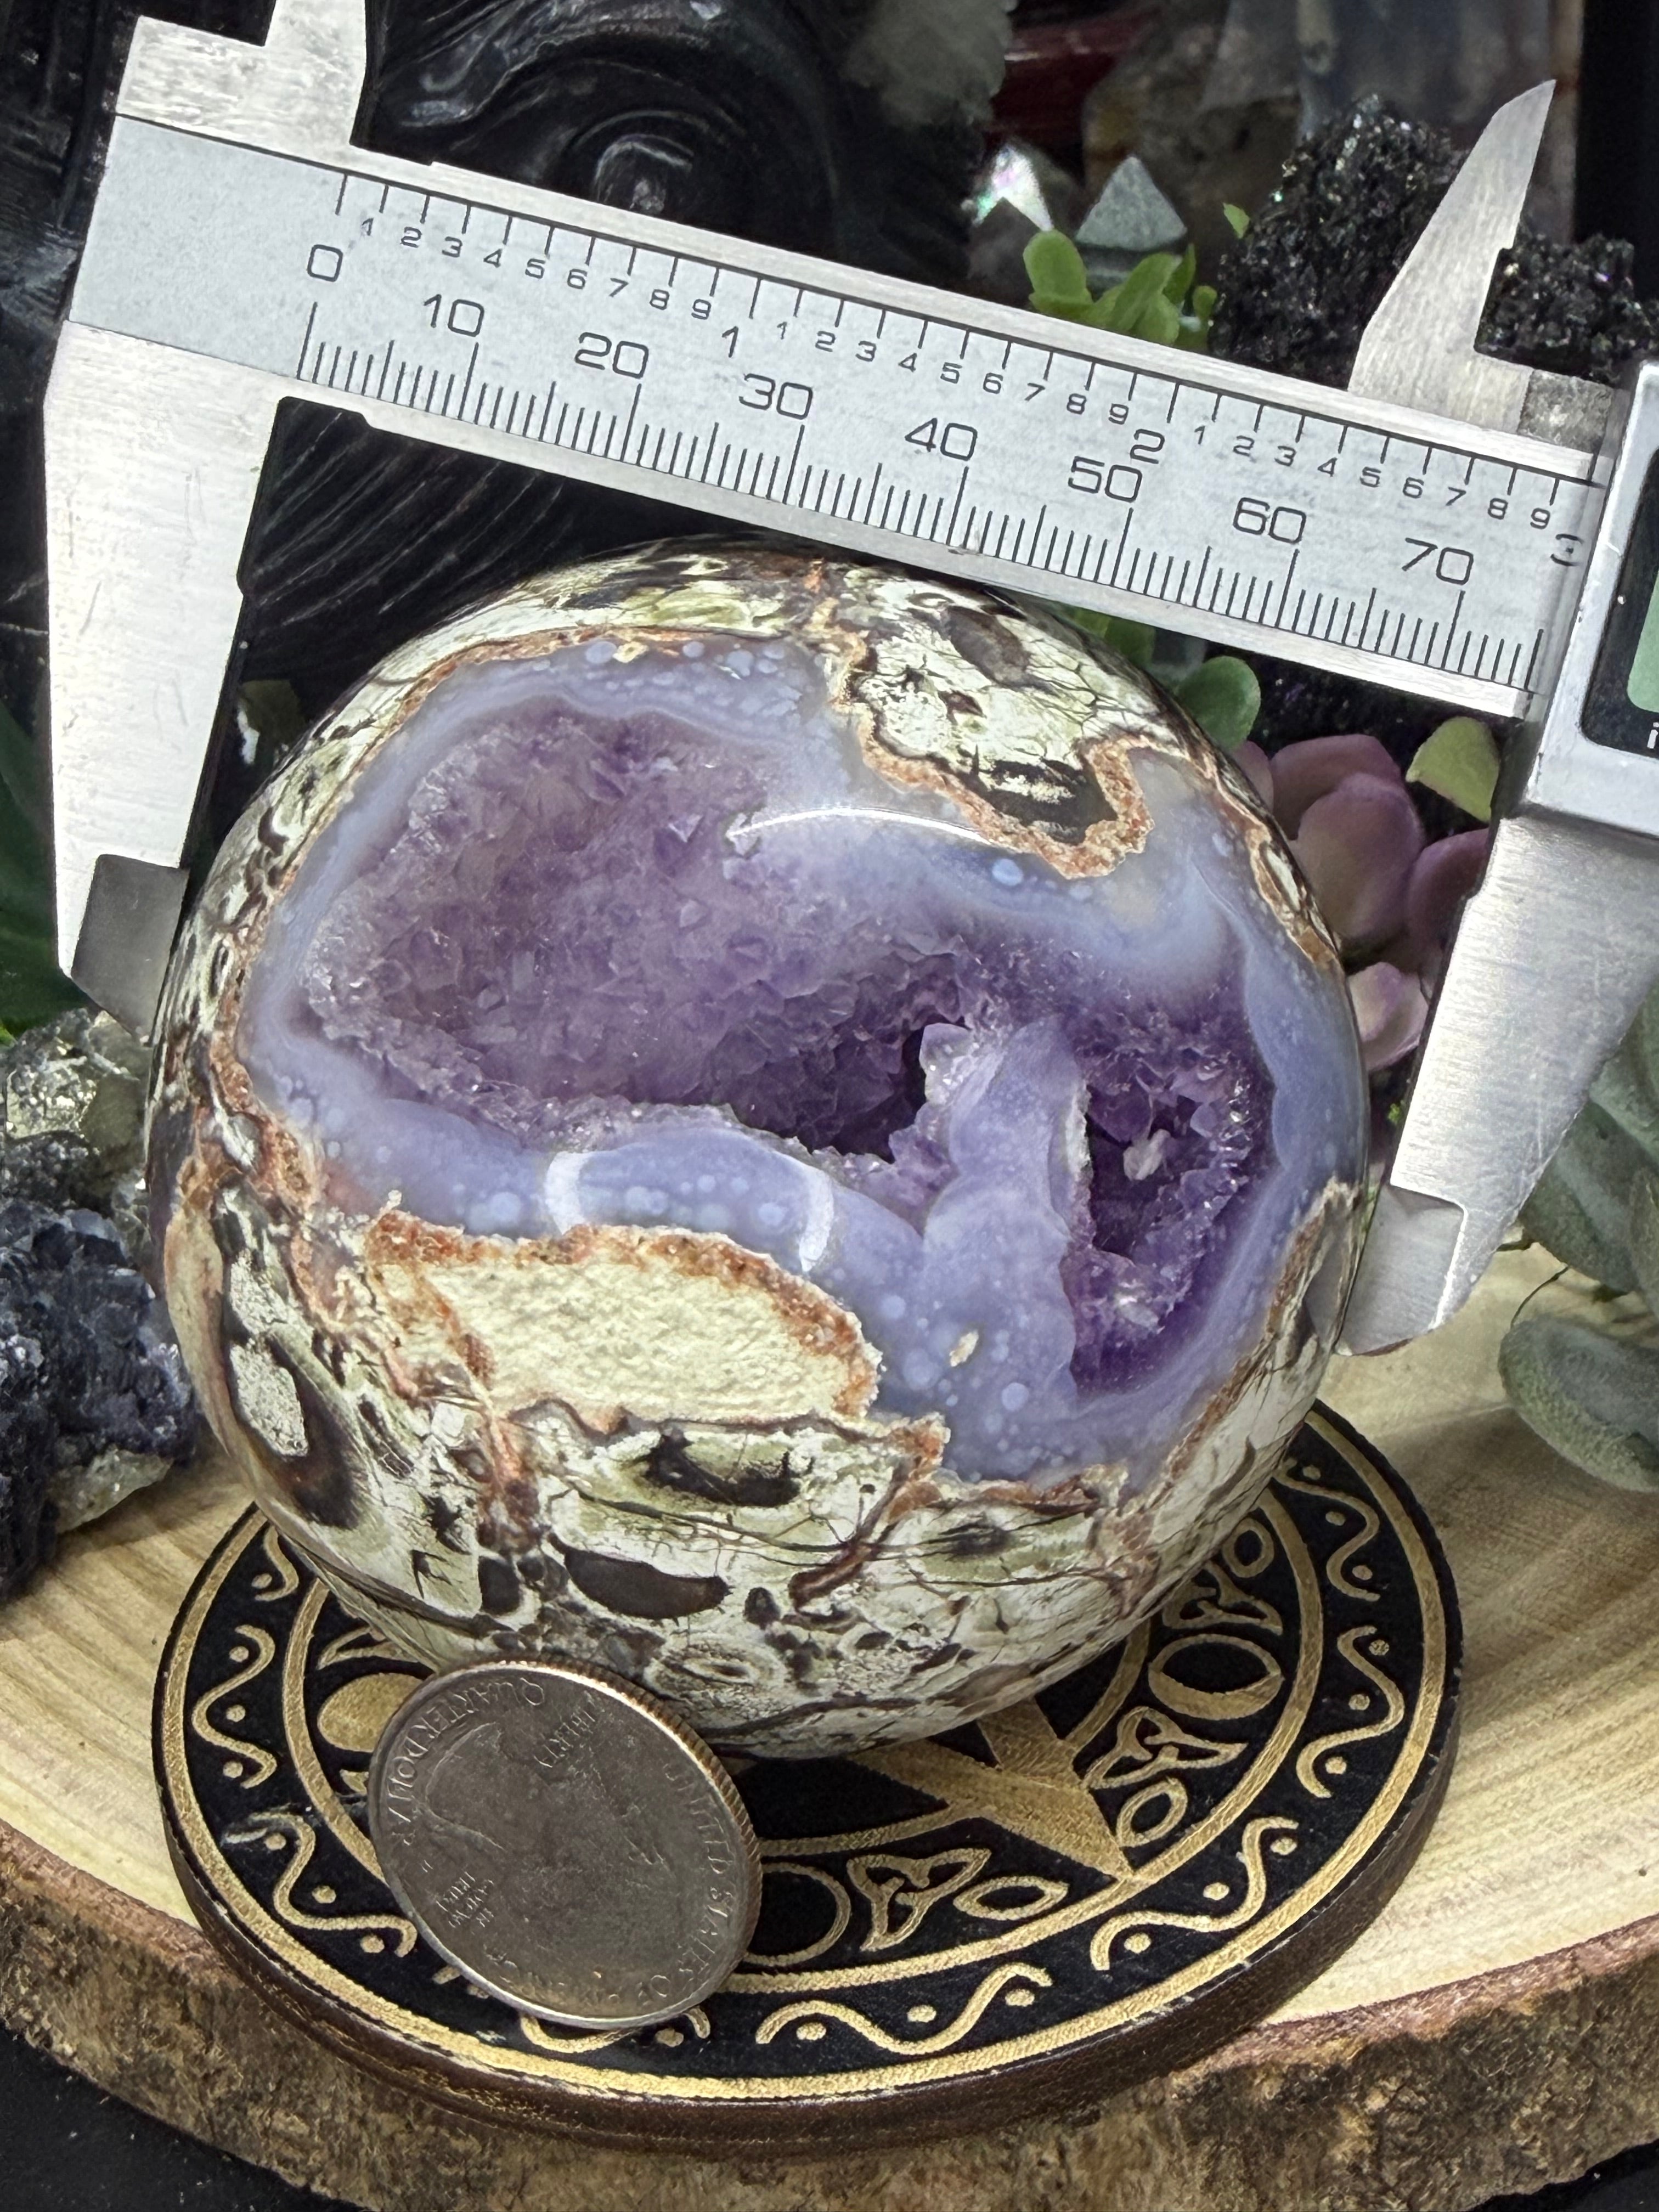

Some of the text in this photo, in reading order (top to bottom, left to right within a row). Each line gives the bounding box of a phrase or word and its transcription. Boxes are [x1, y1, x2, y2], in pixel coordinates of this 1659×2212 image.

[305, 243, 1475, 586] 0 10 20 30 40 50 60 70
[360, 217, 375, 237] 1
[399, 225, 423, 249] 2
[441, 235, 464, 259] 3
[482, 248, 503, 269] 4
[524, 257, 546, 280] 5
[566, 268, 588, 291] 6
[608, 277, 630, 298] 7
[648, 288, 671, 312] 8
[690, 298, 713, 321] 9
[721, 325, 740, 359] 1
[776, 320, 788, 341] 1
[814, 330, 837, 353] 2
[854, 340, 878, 363] 3
[897, 352, 918, 374] 4
[939, 361, 963, 385] 5
[982, 371, 1005, 395] 6
[1023, 382, 1046, 403] 7
[1065, 392, 1088, 416] 8
[1107, 403, 1130, 426] 9
[1128, 428, 1166, 465] 2
[1193, 425, 1206, 446] 1
[1232, 435, 1256, 458] 2
[1273, 444, 1297, 468] 3
[1316, 456, 1338, 478] 4
[1358, 466, 1382, 489] 5
[1401, 476, 1425, 500] 6
[1444, 486, 1468, 507] 7
[1486, 497, 1509, 521] 8
[1529, 507, 1551, 531] 9
[386, 1677, 545, 1846] QUARTER DOLLAR
